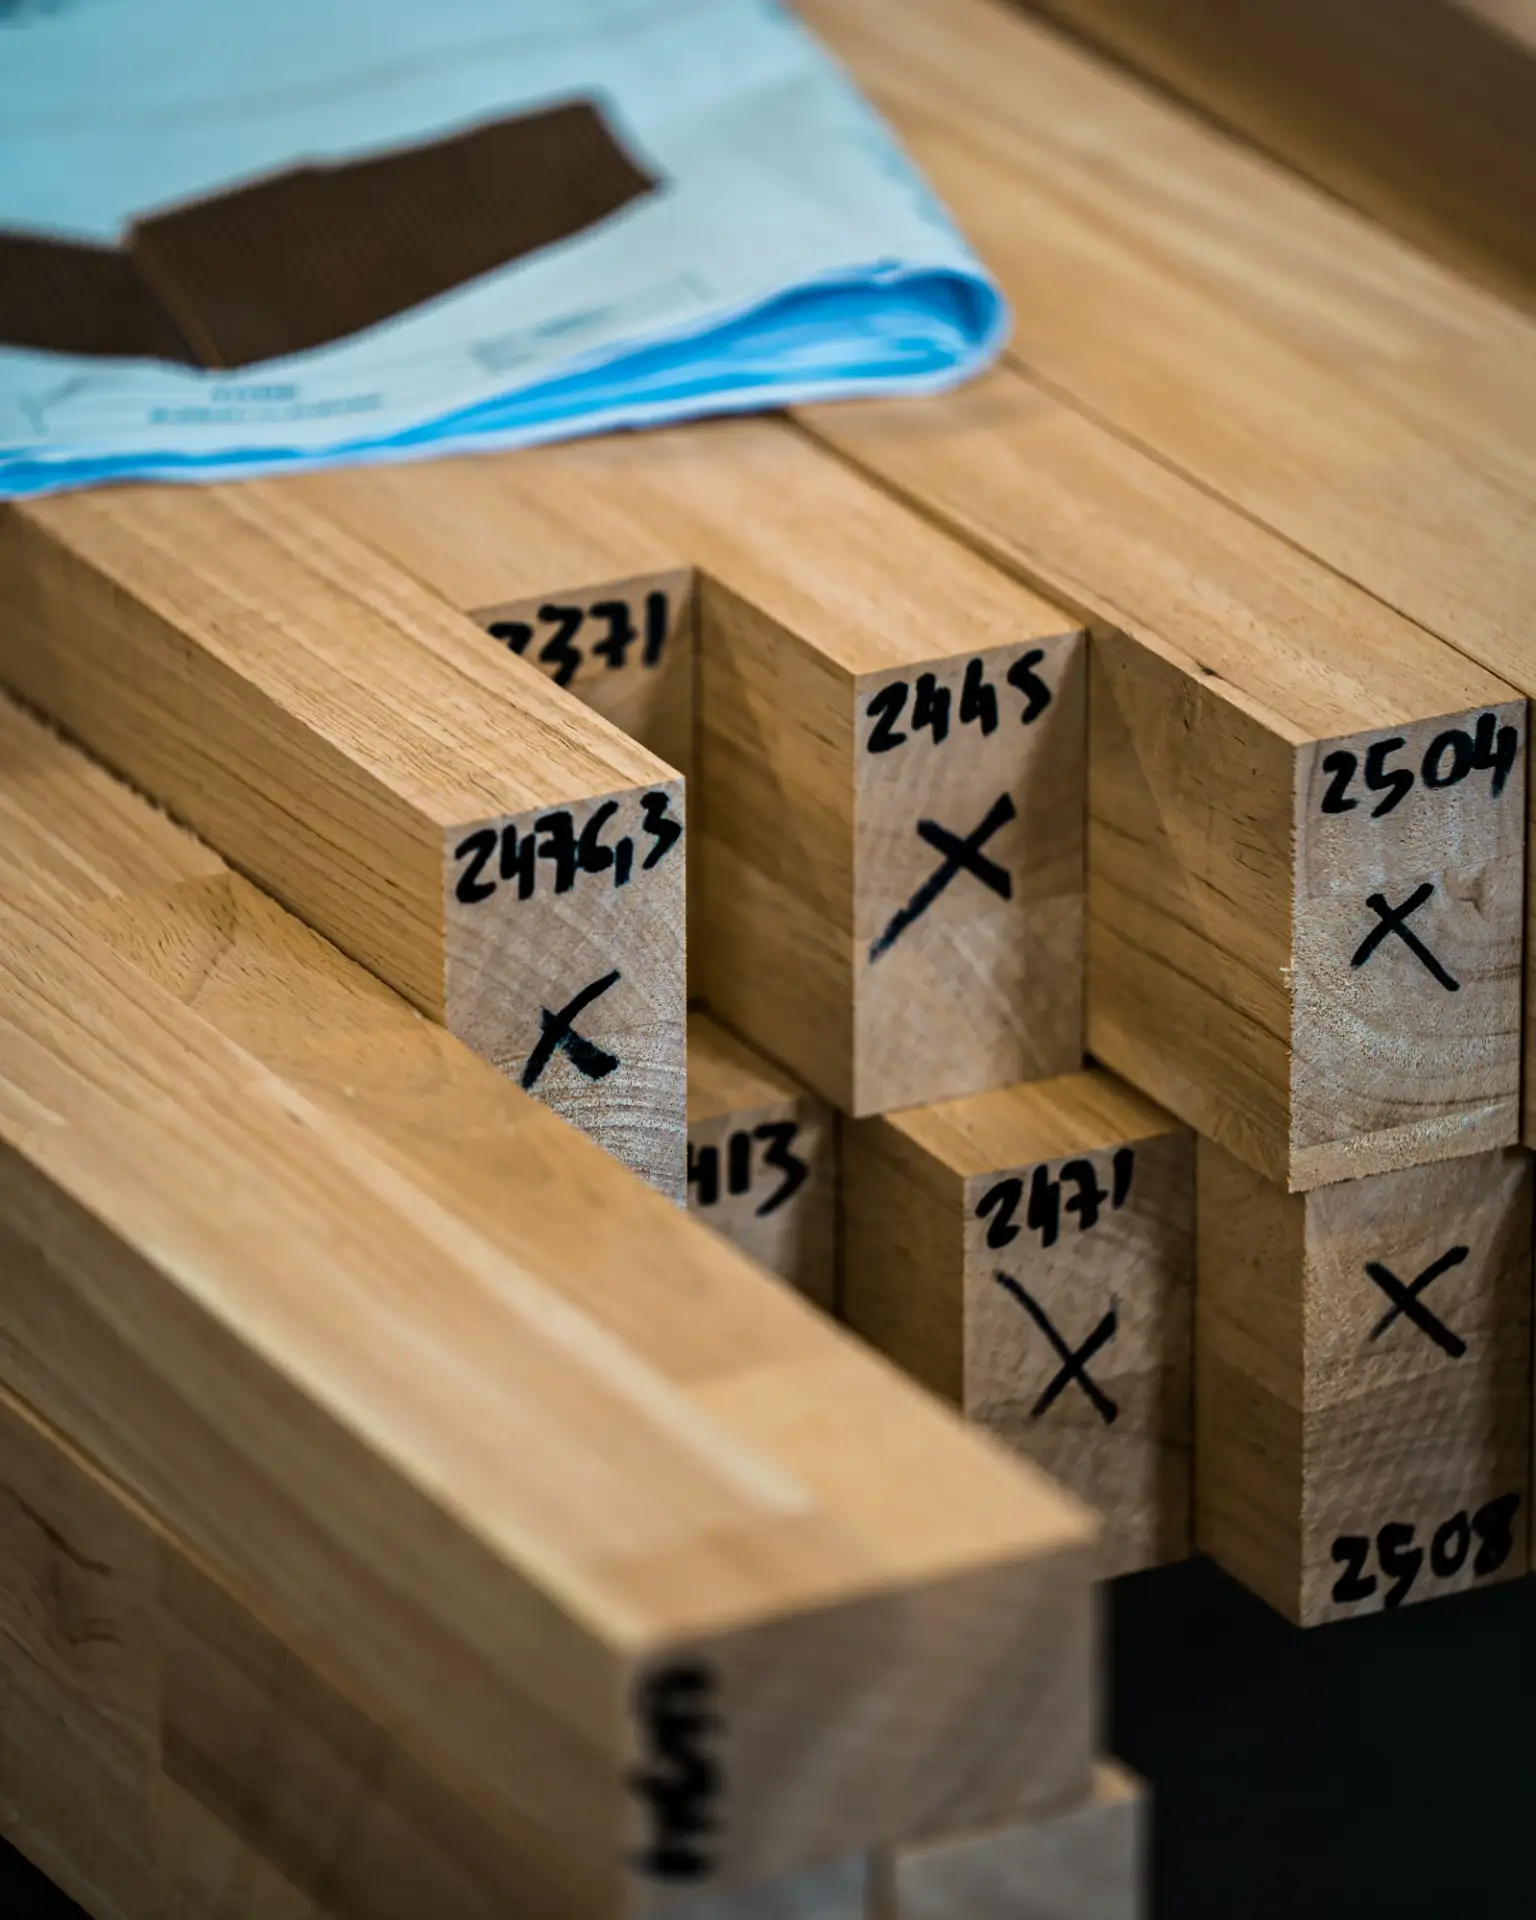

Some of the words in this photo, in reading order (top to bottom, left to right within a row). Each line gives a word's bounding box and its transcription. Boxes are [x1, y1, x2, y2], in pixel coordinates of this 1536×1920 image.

[866, 649, 1052, 754] 2445
[1320, 712, 1518, 818] 2504
[454, 791, 682, 904] 2476,3
[974, 1147, 1135, 1249] 2471
[1330, 1492, 1521, 1608] 2508
